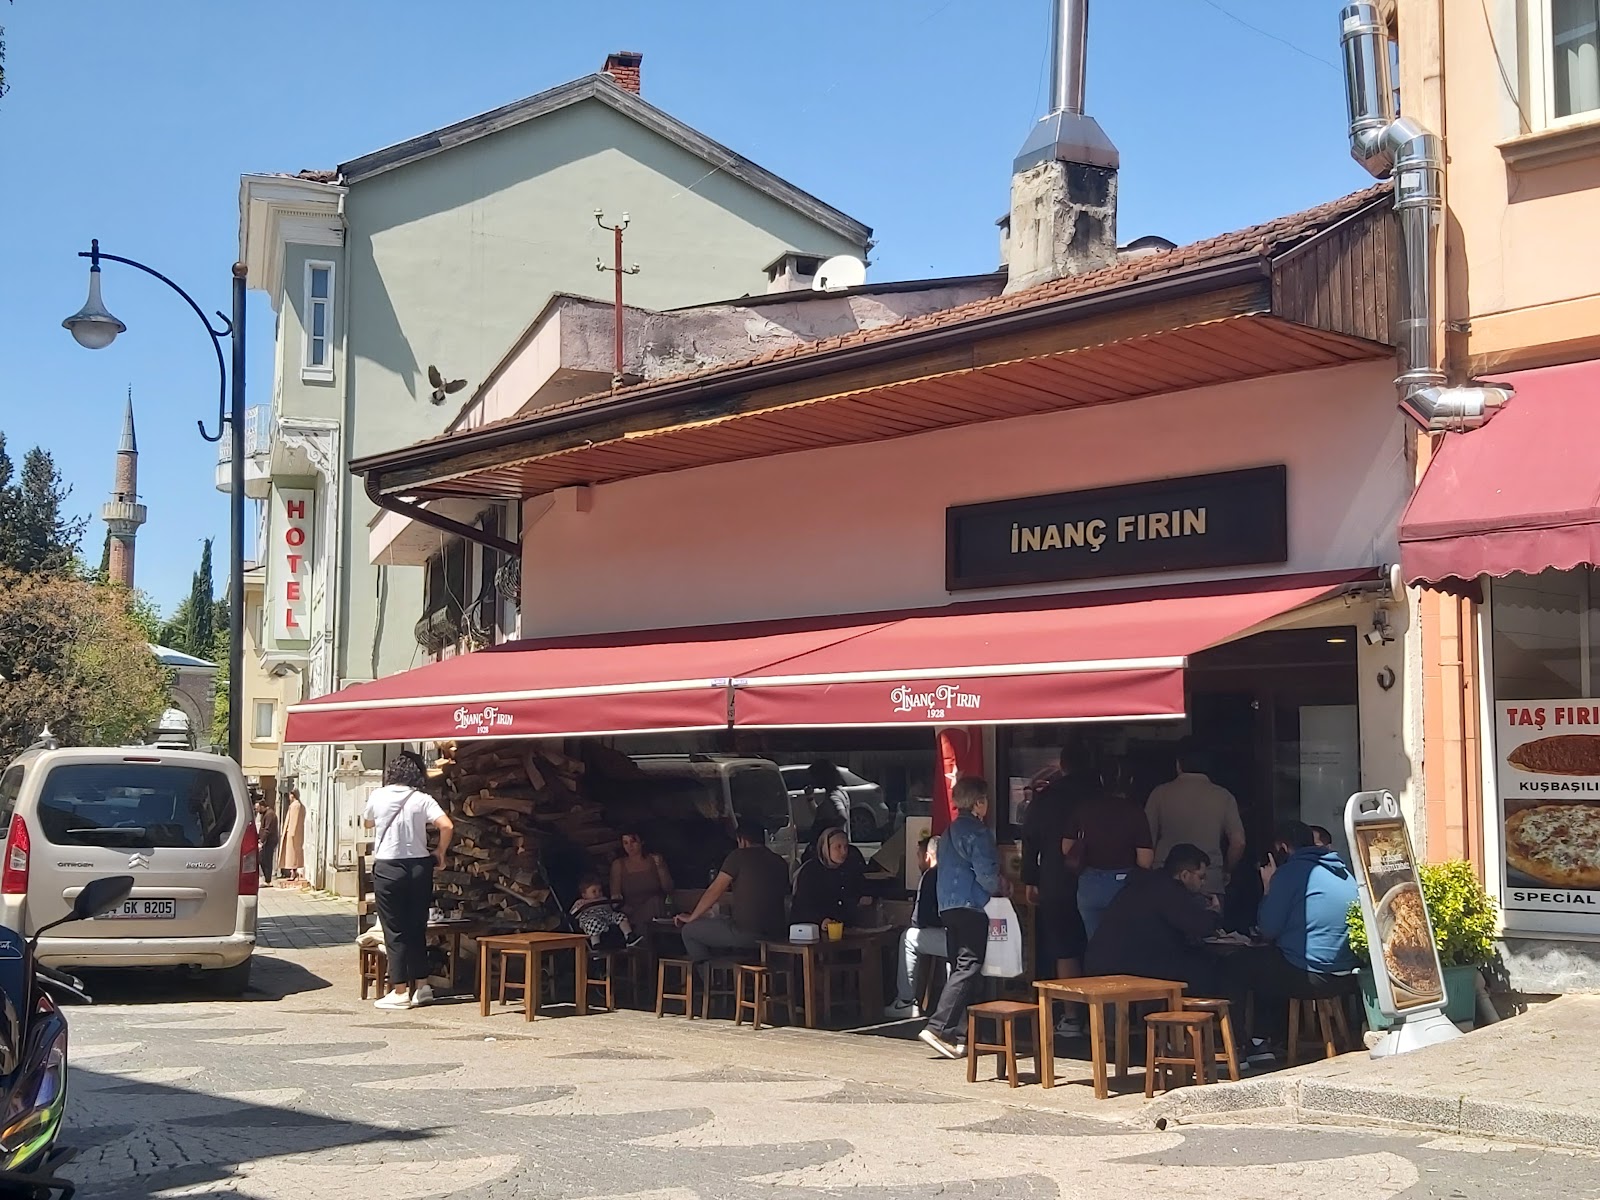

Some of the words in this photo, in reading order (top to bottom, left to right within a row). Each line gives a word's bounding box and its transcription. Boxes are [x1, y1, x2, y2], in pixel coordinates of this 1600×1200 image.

[1010, 518, 1107, 553] İNANÇ
[1117, 507, 1206, 543] FIRIN
[285, 500, 305, 628] HOTEL
[927, 709, 945, 718] 1928
[1506, 707, 1546, 731] TAŞ
[1519, 781, 1599, 793] KUŞBAŞILI
[1513, 892, 1596, 905] SPECİAL
[124, 902, 138, 914] GK
[144, 902, 172, 914] 8205
